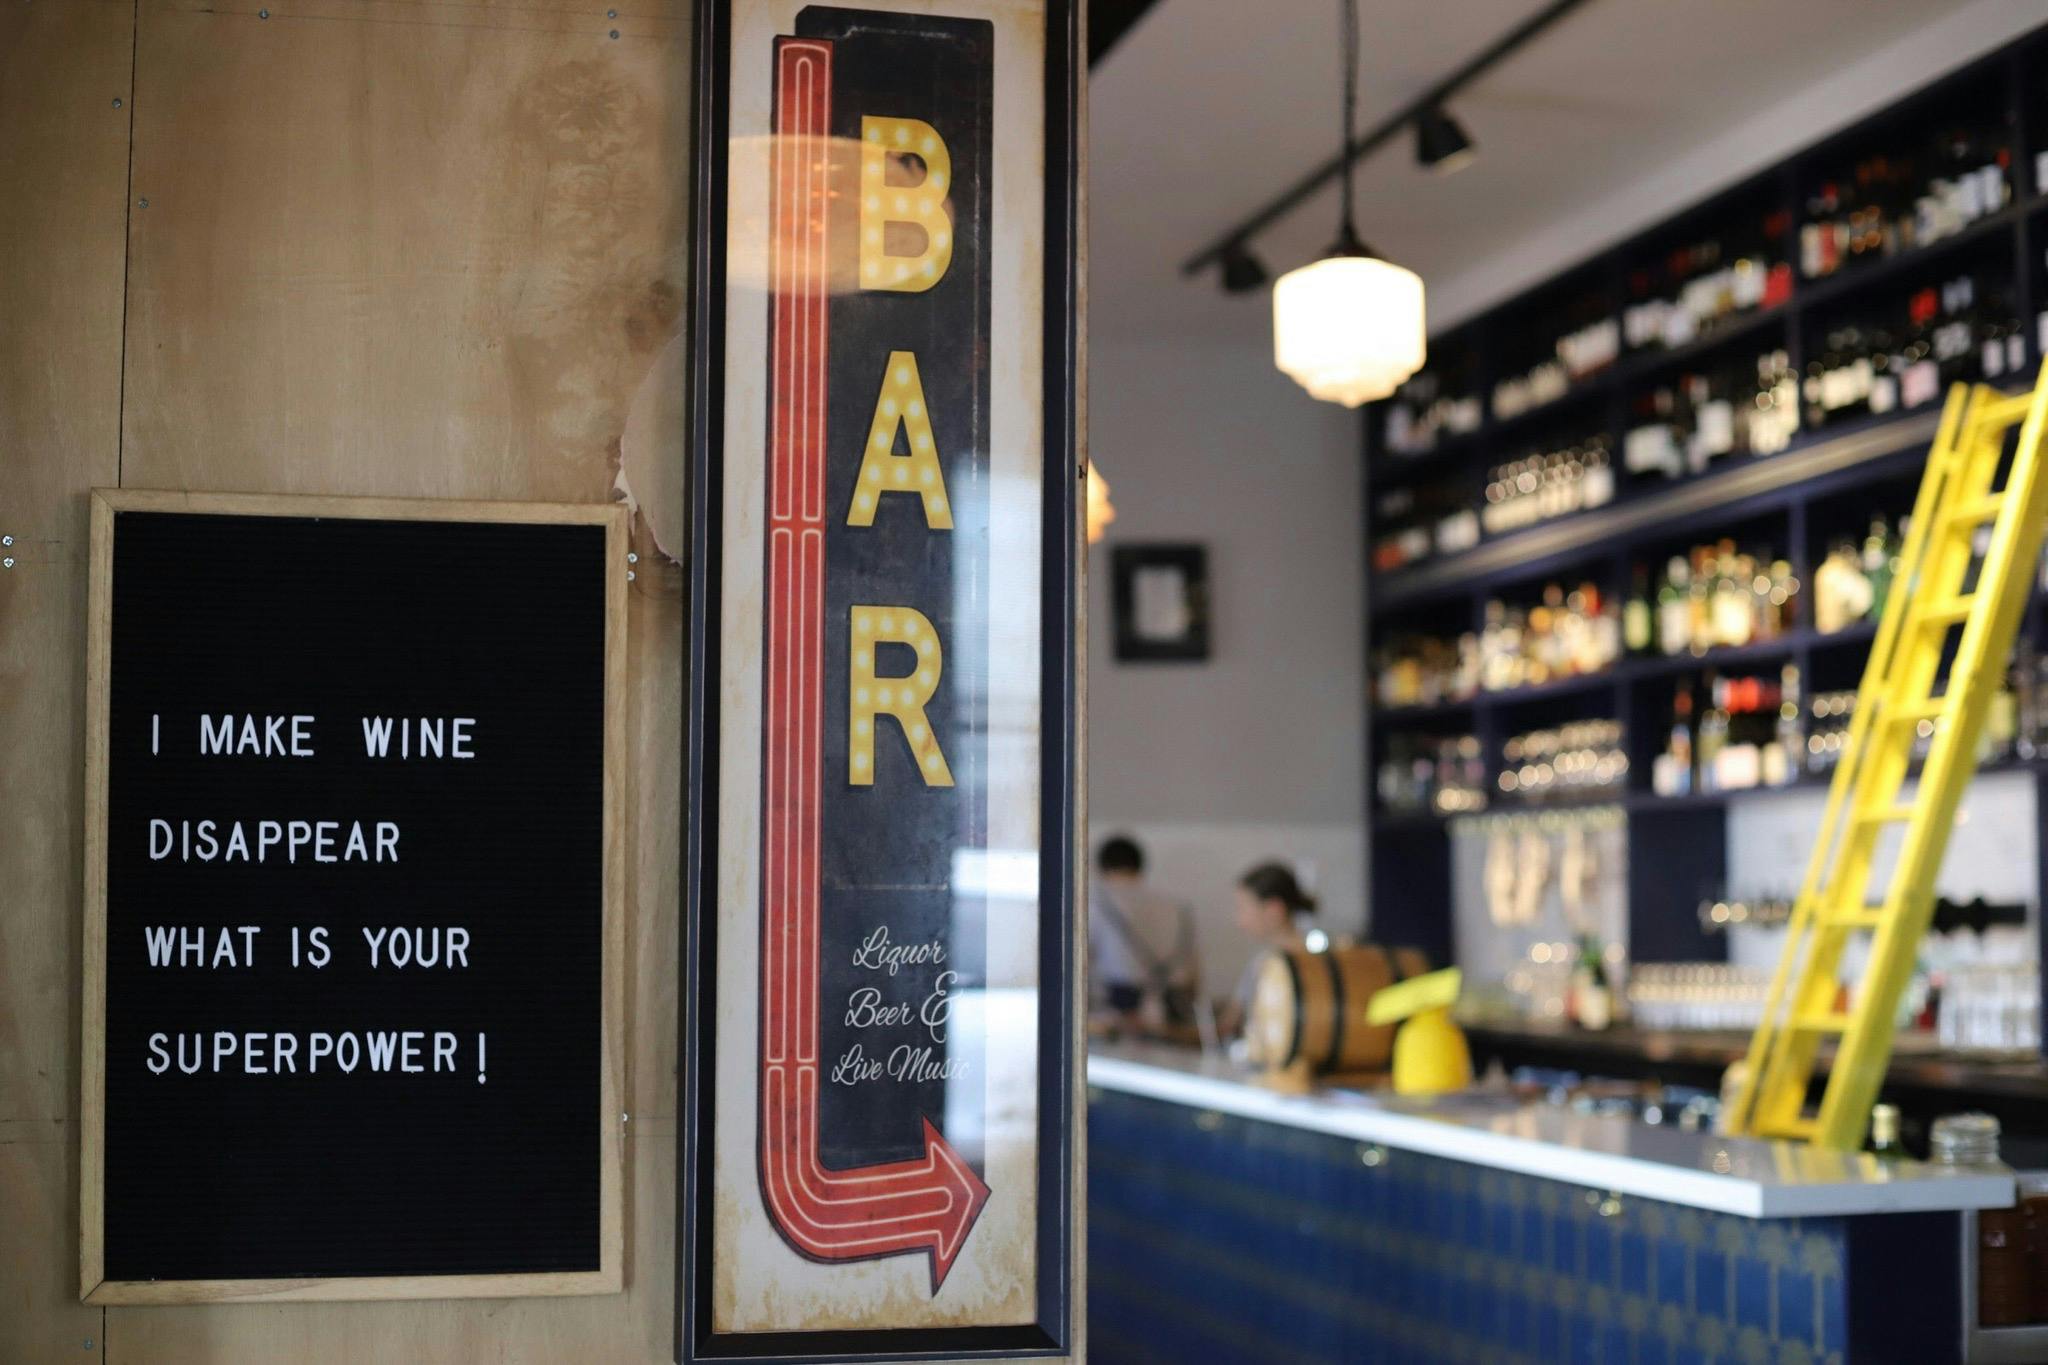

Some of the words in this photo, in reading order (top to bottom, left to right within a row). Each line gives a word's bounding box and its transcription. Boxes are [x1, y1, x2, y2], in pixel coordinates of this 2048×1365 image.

[848, 115, 956, 788] BAR
[152, 714, 160, 756] I
[200, 713, 315, 757] MAKE
[362, 715, 476, 759] WINE
[149, 818, 400, 863] DISAPPEAR
[145, 925, 261, 969] WHAT
[291, 926, 331, 969] IS
[362, 926, 470, 969] YOUR
[853, 926, 947, 976] Liquor
[845, 988, 915, 1027] Beer
[920, 970, 964, 1043] &
[831, 1044, 883, 1085] Live
[887, 1045, 970, 1083] Music
